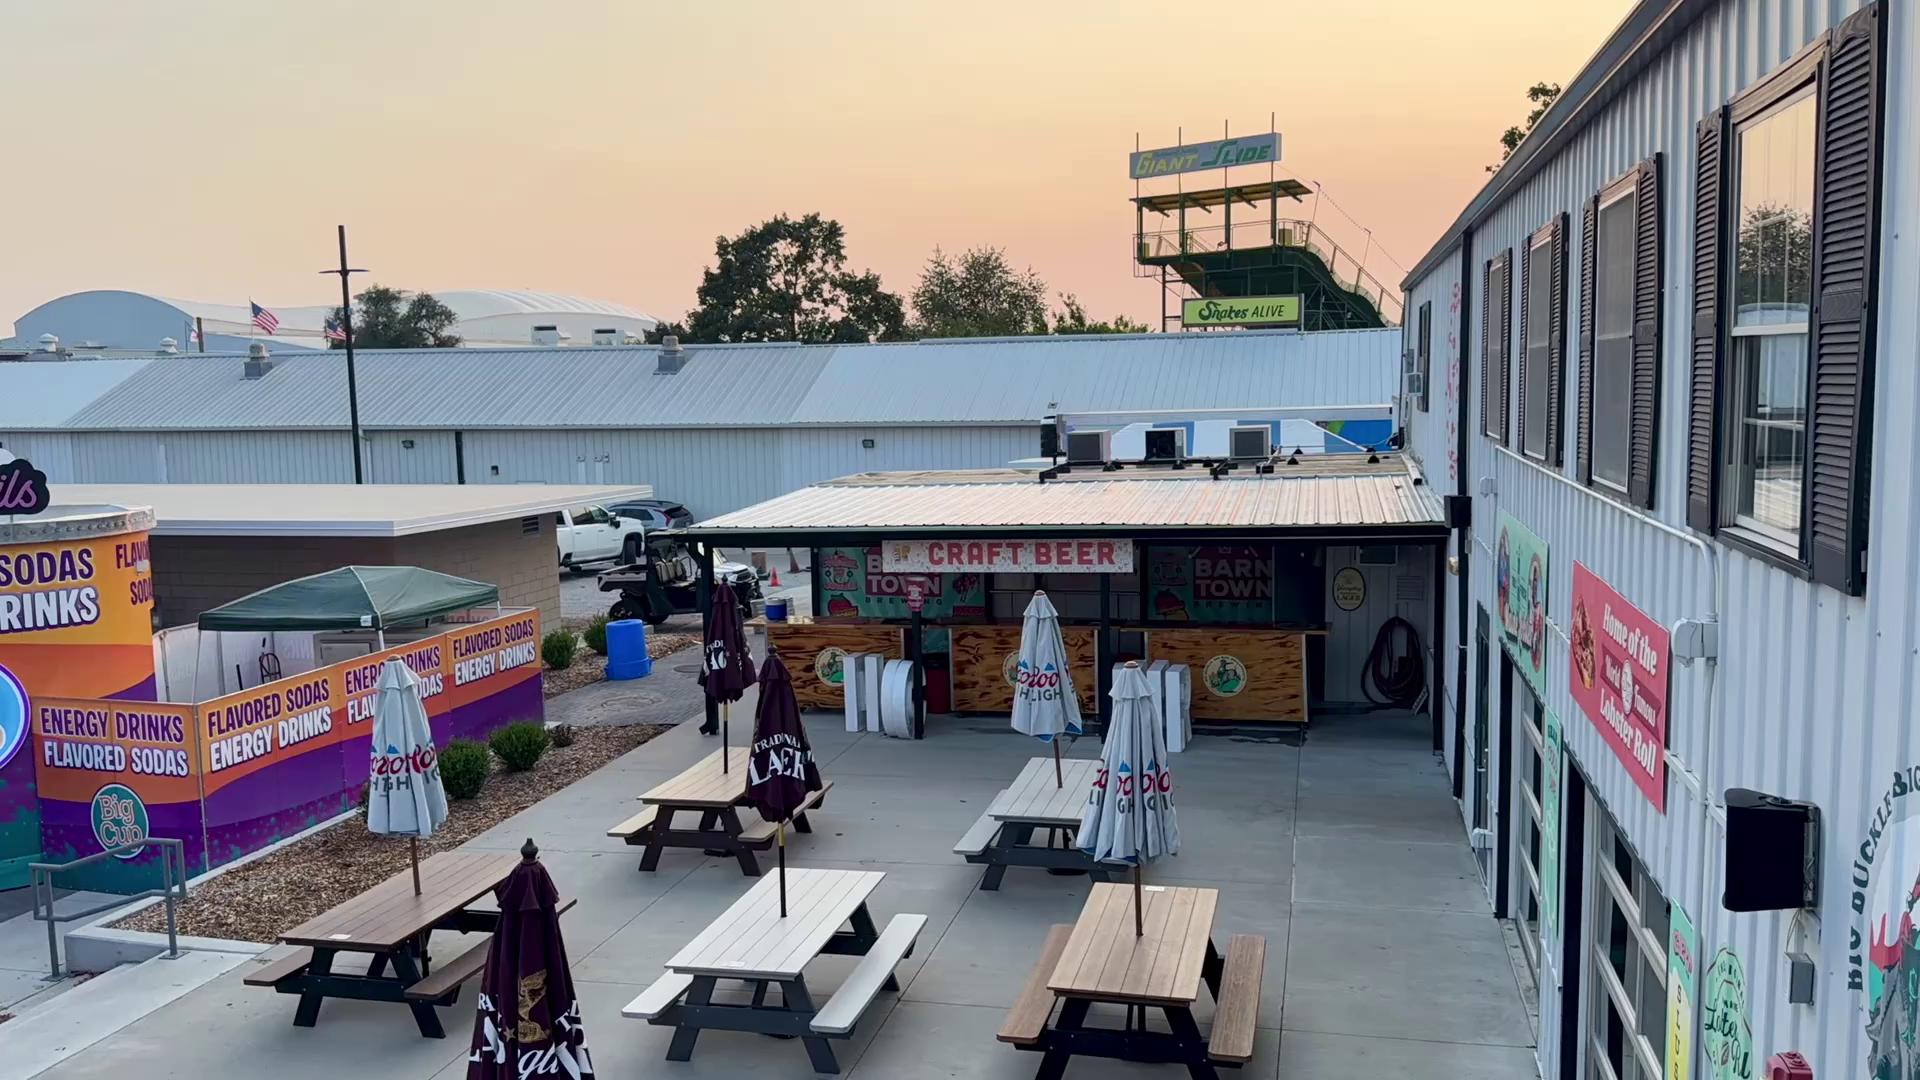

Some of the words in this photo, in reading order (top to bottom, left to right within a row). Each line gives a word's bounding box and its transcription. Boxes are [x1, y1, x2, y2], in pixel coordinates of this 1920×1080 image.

[1136, 152, 1199, 176] GIANT
[1200, 141, 1272, 168] SLIDE
[1198, 300, 1250, 322] Snakes
[1251, 304, 1286, 318] ALIVE
[0, 469, 38, 508] ils
[928, 542, 1023, 566] CRAFT
[1034, 542, 1116, 565] BEER
[1195, 558, 1273, 577] BARN
[1195, 579, 1273, 597] TOWN
[0, 587, 98, 632] RINKS
[452, 627, 501, 660] FLAVORED
[504, 618, 534, 644] SODAS
[1602, 602, 1628, 647] Home
[1628, 627, 1642, 657] of
[1639, 635, 1658, 677] the
[454, 651, 497, 687] ENERGY
[499, 641, 536, 673] DRINKS
[207, 692, 282, 738] FLAVORED
[285, 677, 330, 713] SODAS
[347, 693, 381, 725] FLAV
[414, 673, 444, 700] ODAS
[40, 707, 109, 738] ENERGY
[115, 711, 185, 744] DRINKS
[210, 723, 274, 774] ENERGY
[278, 705, 333, 750] DRINKS
[1600, 687, 1635, 749] Lobster
[1633, 727, 1658, 779] Roll
[43, 740, 126, 772] FLAVORED
[130, 747, 190, 778] SODAS
[98, 793, 135, 826] Big
[100, 820, 143, 847] Cup
[1851, 790, 1893, 915] BUCKLE
